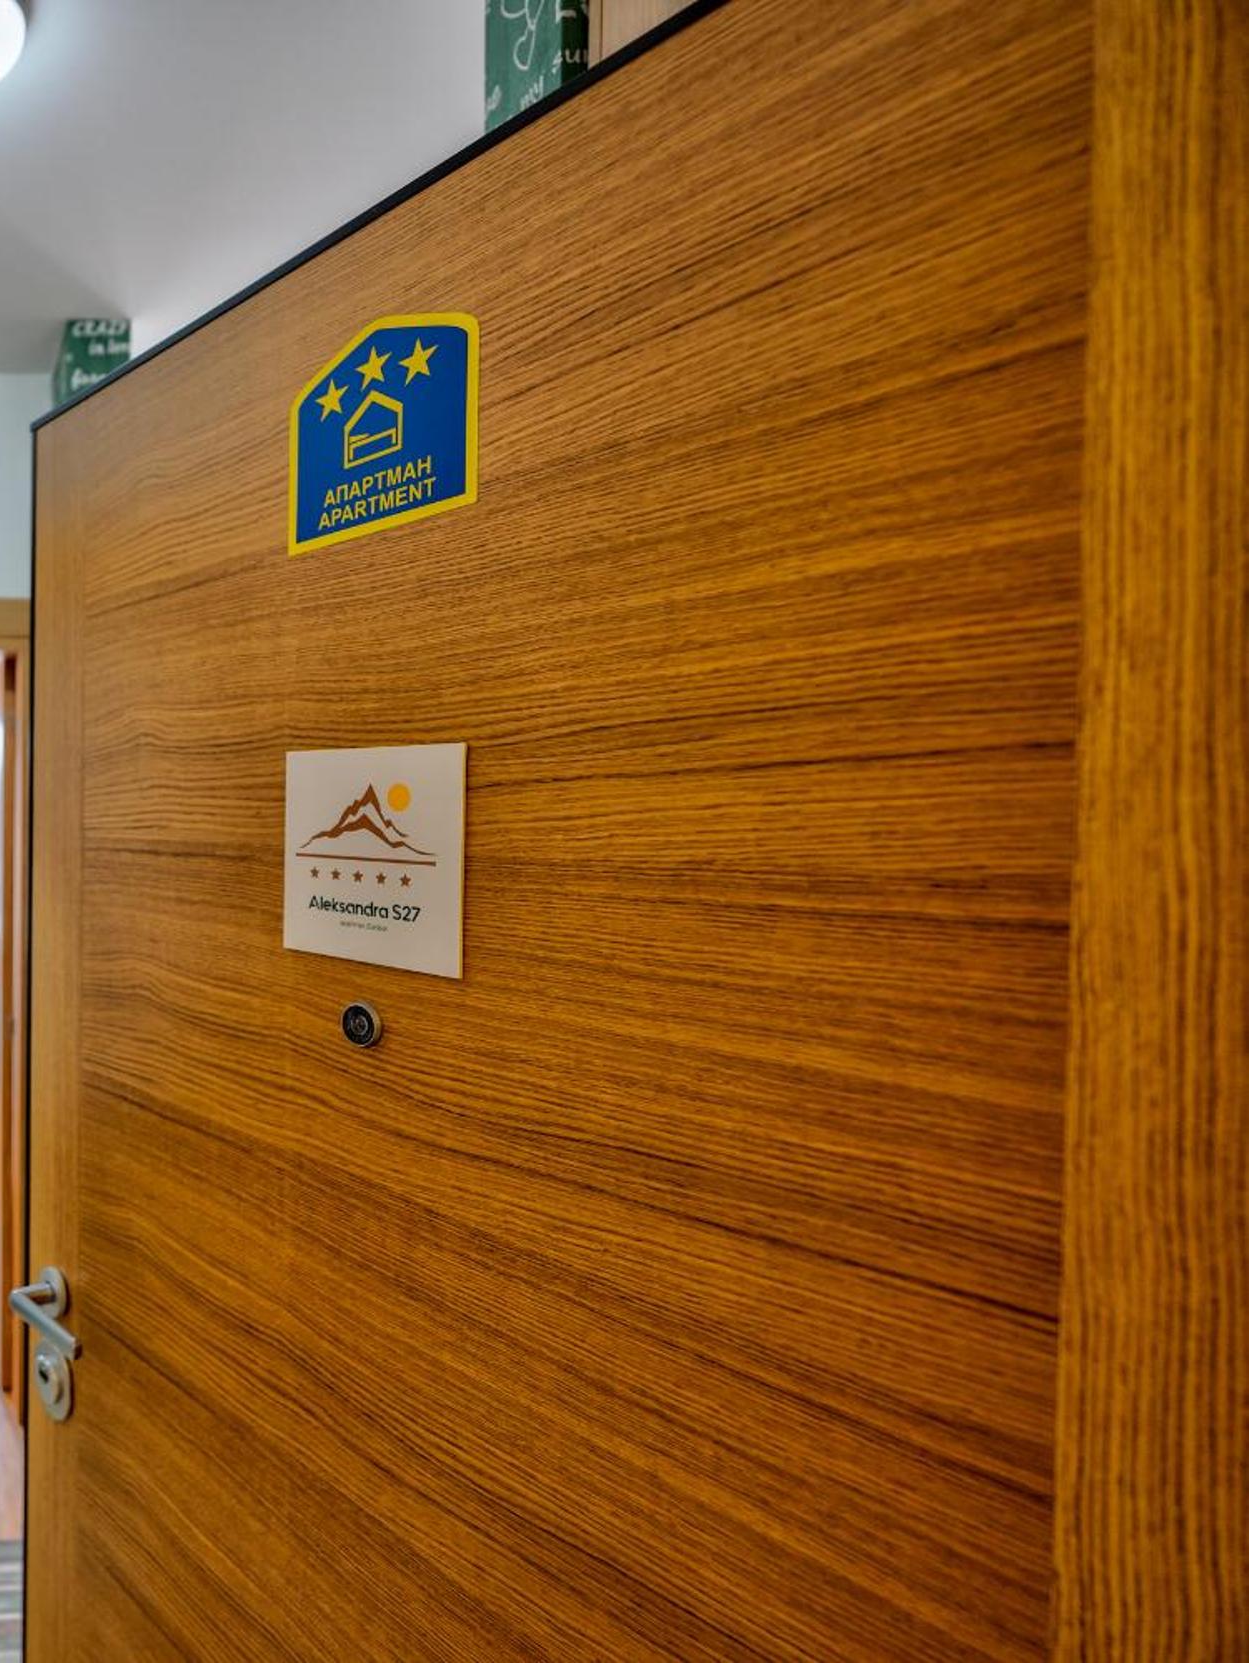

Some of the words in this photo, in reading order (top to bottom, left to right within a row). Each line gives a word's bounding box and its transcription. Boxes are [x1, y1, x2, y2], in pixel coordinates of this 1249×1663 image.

[317, 476, 436, 531] APARTMENT
[323, 455, 432, 507] АПАРТМАН
[308, 895, 389, 919] Aleksandra
[393, 904, 421, 923] S27
